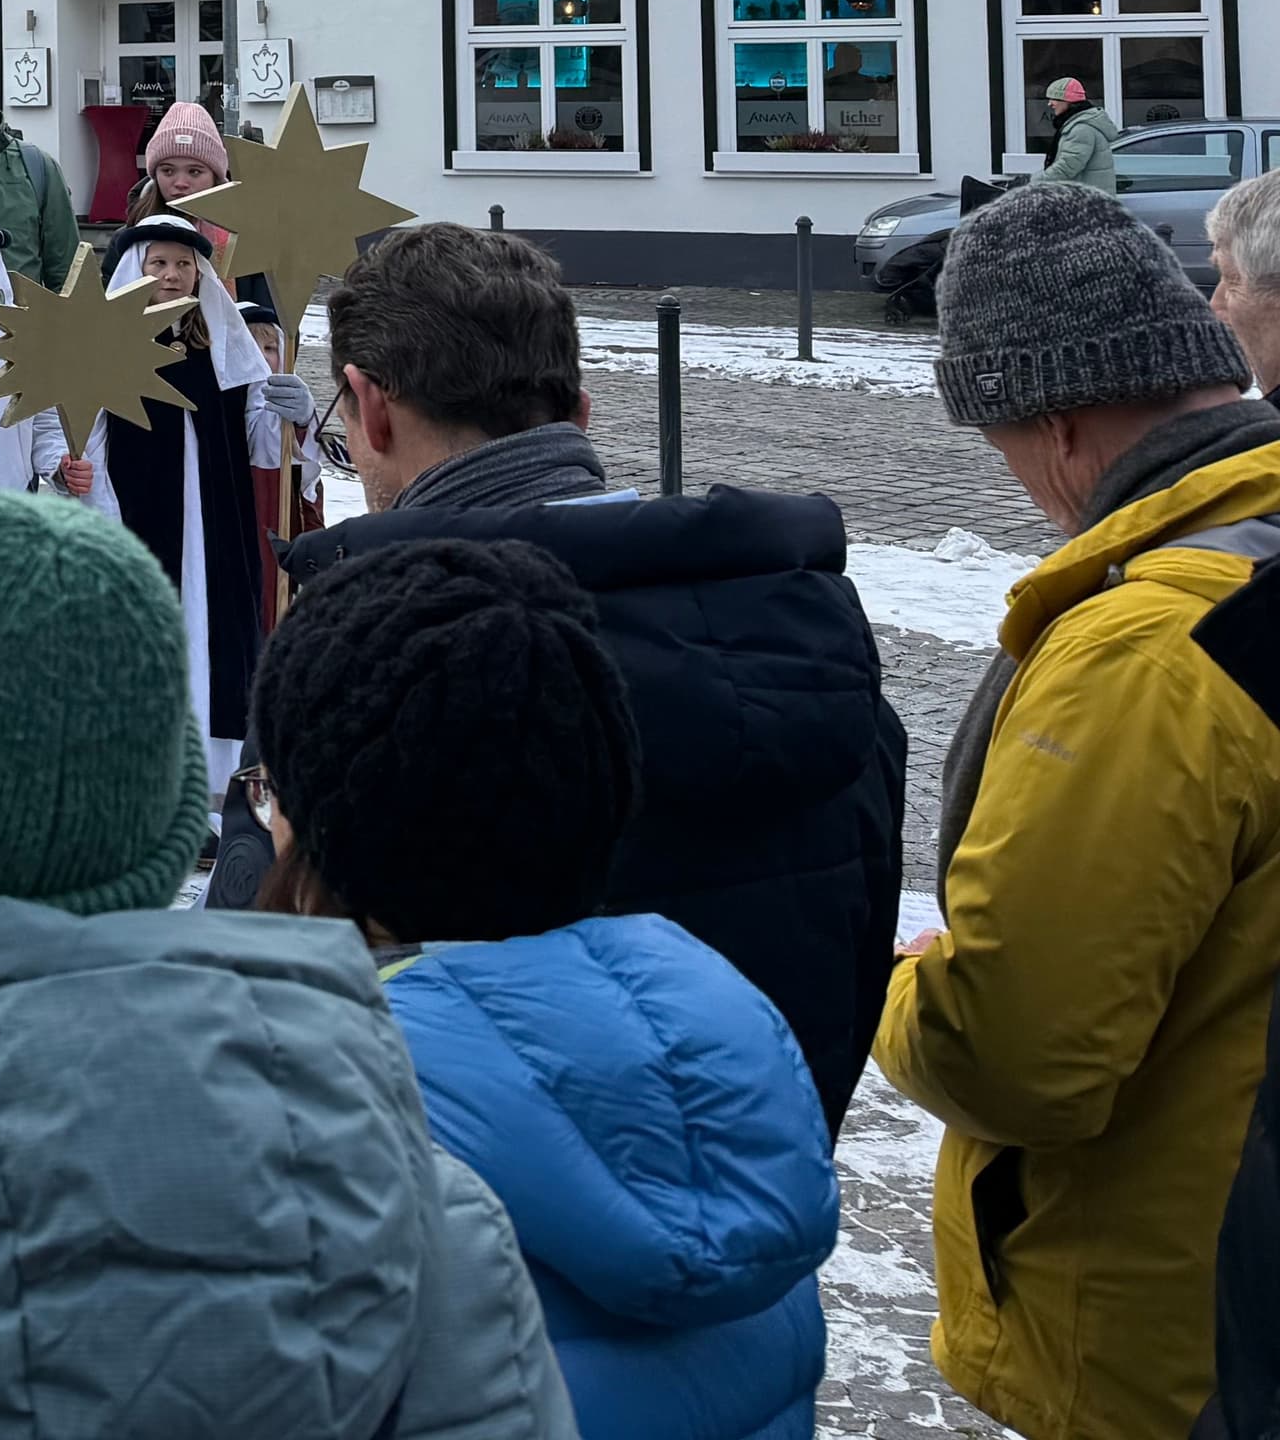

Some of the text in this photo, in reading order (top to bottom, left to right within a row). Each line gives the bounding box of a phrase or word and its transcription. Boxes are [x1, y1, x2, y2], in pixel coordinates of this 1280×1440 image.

[132, 82, 164, 92] ANAYA
[485, 112, 534, 126] ANAYA
[746, 111, 799, 126] ANAYA
[841, 110, 885, 126] Licher
